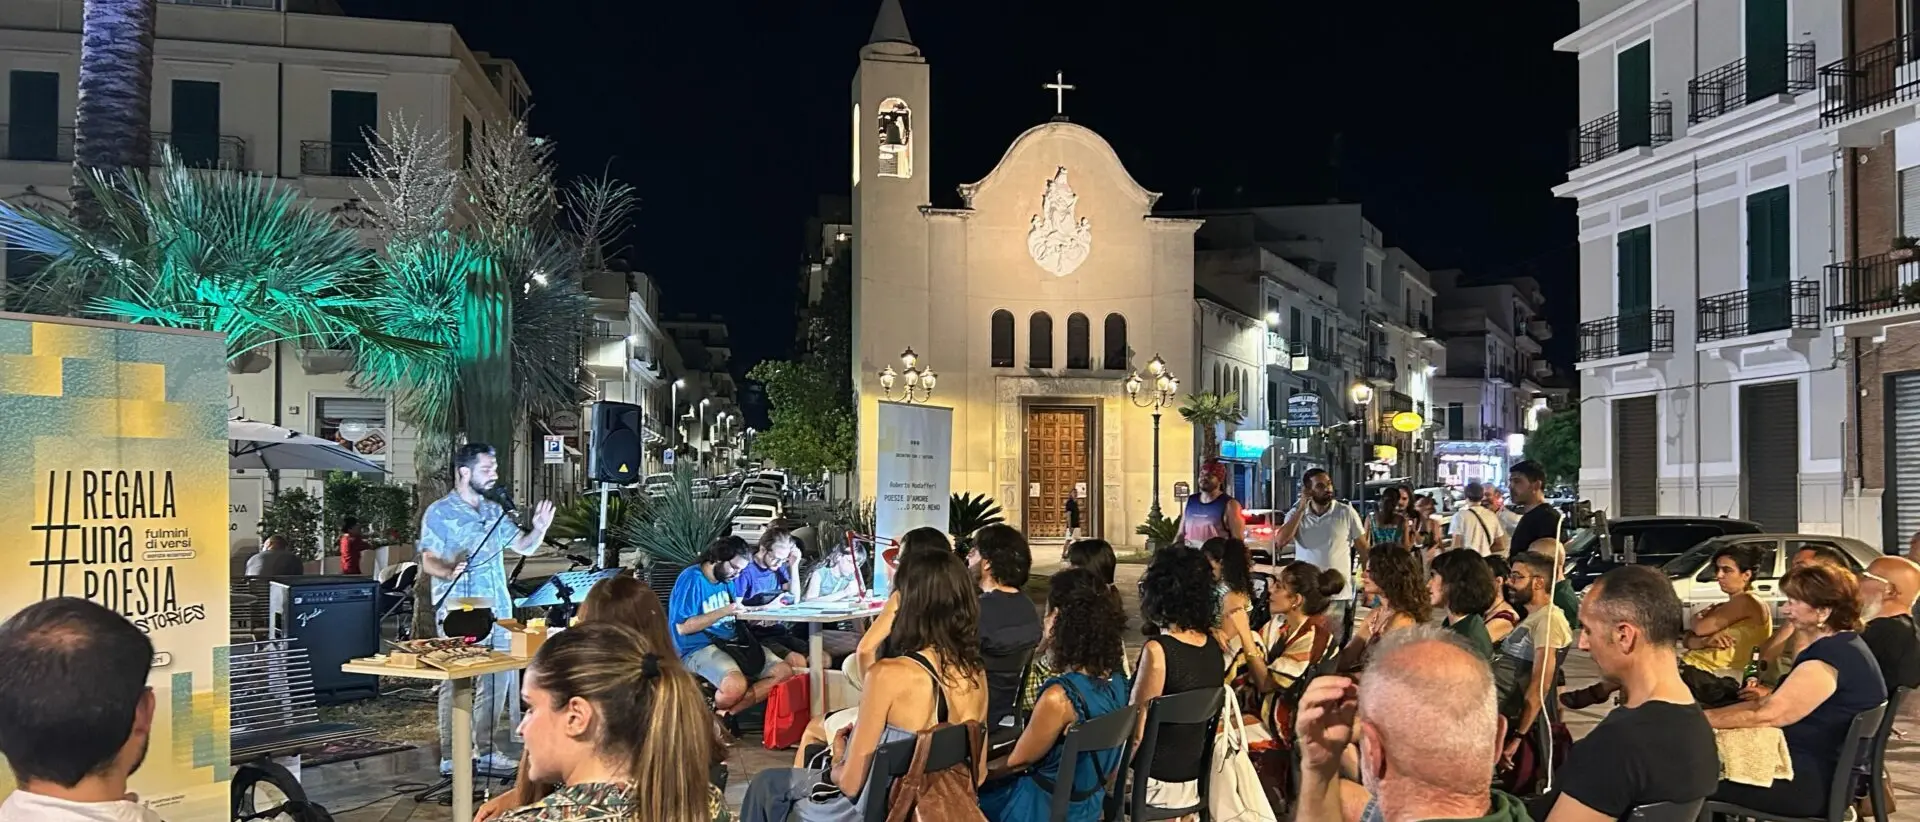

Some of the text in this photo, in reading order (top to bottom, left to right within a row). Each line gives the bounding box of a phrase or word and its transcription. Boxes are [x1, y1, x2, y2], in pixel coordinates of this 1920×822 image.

[550, 441, 558, 451] P
[83, 470, 176, 519] REGALA
[884, 494, 929, 503] POESIE D'AMORE
[911, 503, 926, 511] POCO
[927, 503, 941, 511] MENO
[145, 528, 189, 539] fulmini
[81, 525, 133, 565] una
[145, 537, 192, 549] di versi
[84, 566, 177, 617] POESIA
